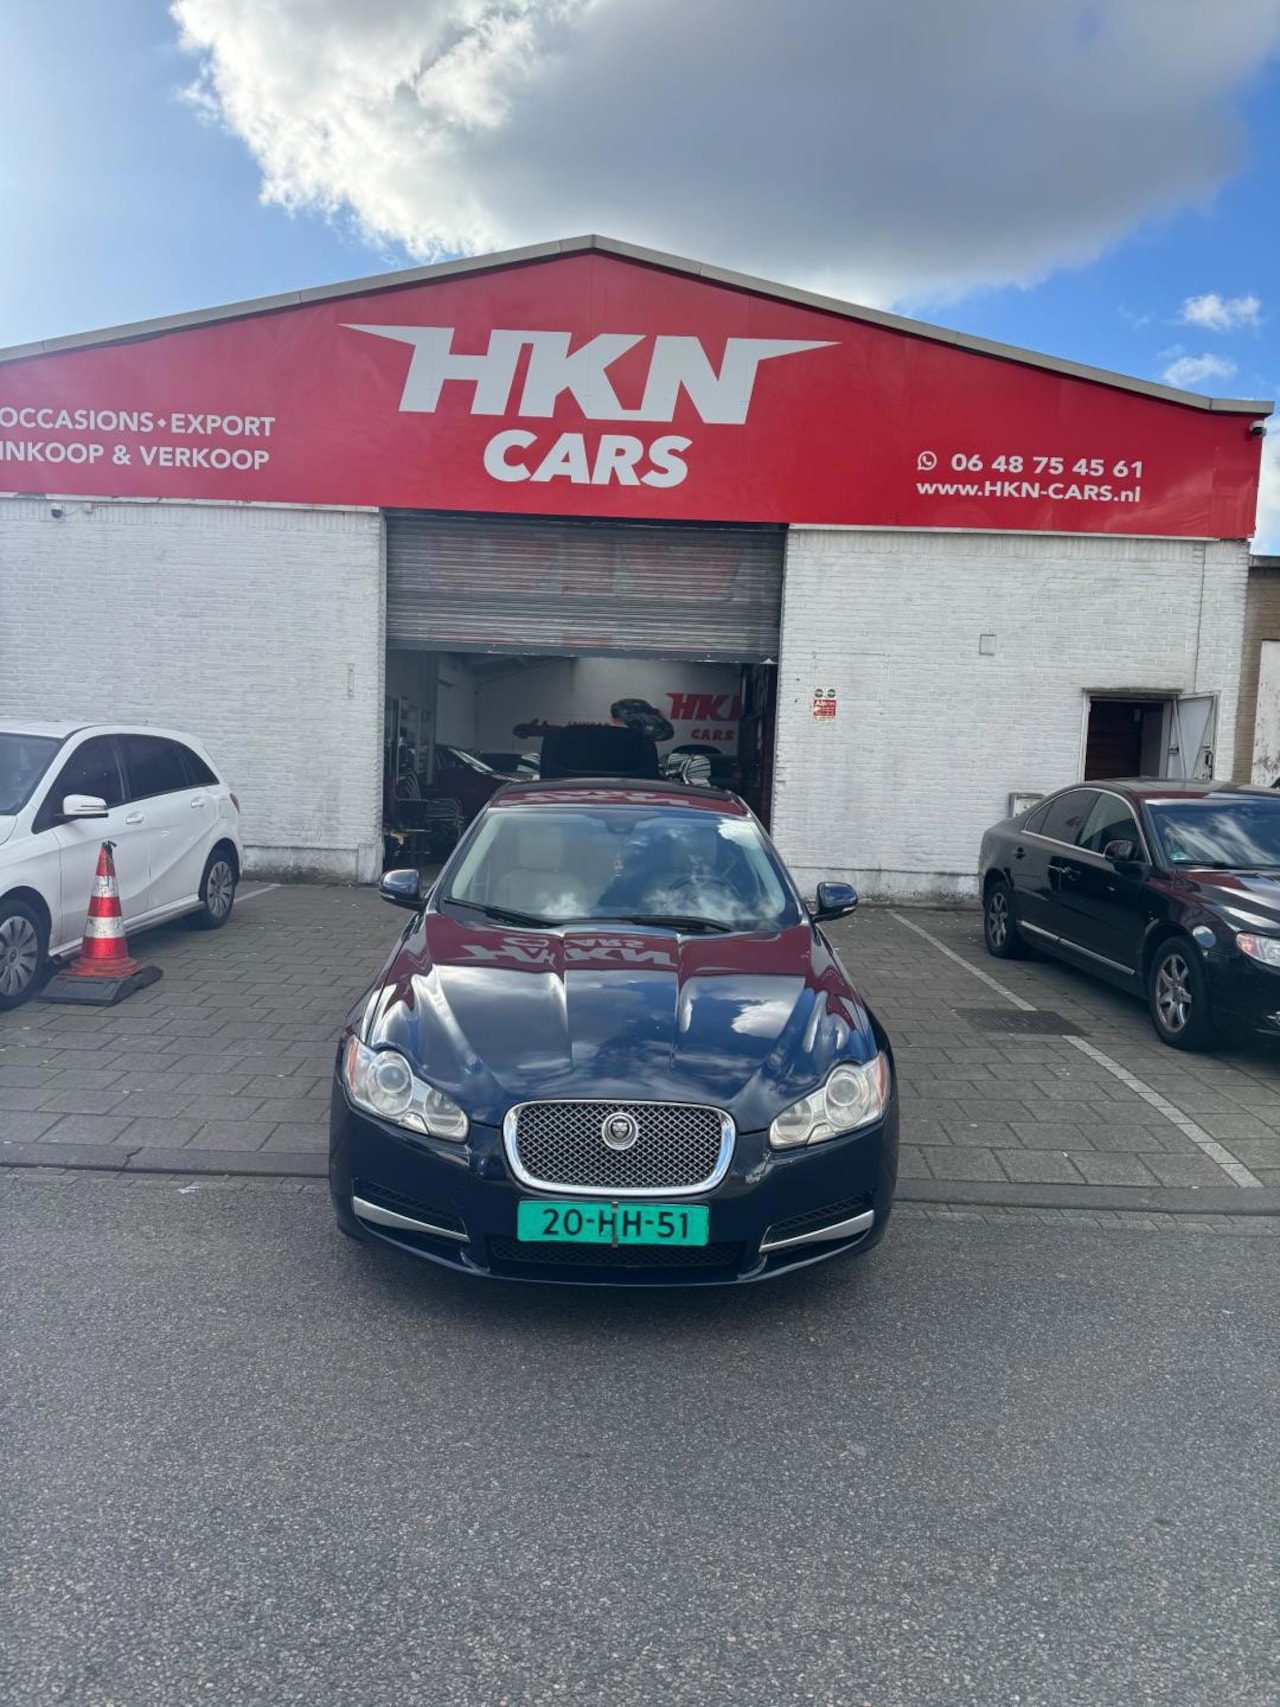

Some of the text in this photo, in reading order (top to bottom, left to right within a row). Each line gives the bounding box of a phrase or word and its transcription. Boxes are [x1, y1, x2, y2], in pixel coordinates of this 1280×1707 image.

[338, 323, 842, 425] HKN
[170, 412, 275, 437] EXPORT
[0, 440, 270, 470] INKOOP & VERKOOP
[484, 429, 693, 488] CARS
[951, 453, 1142, 478] 06 48 75 45 61
[916, 480, 1141, 503] www.HKN-CARS.nl
[691, 728, 736, 741] CARS
[543, 1208, 688, 1239] 20-HH-51
